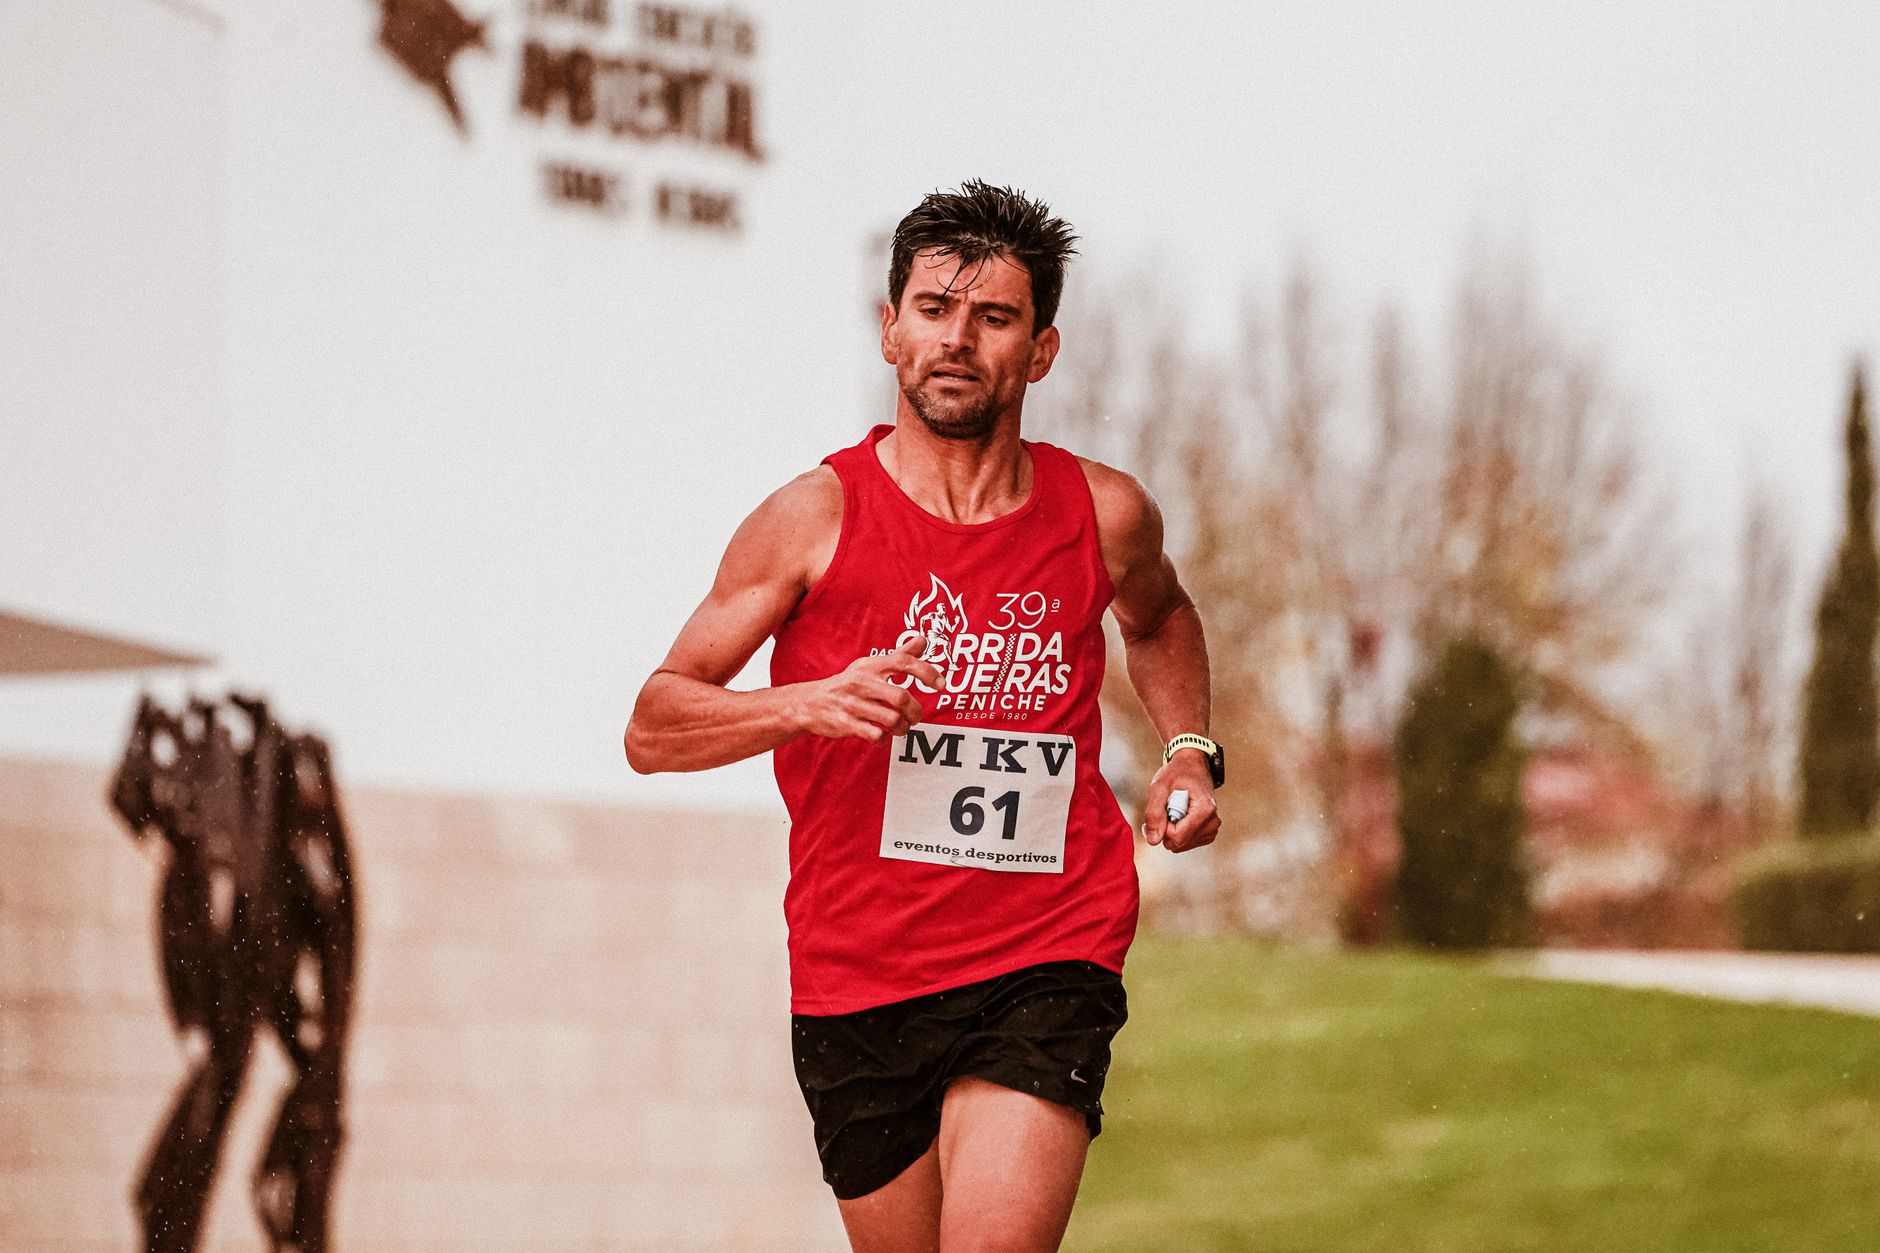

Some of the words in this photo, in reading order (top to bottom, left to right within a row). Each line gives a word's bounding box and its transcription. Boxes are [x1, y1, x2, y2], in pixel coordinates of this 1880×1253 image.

[936, 694, 1047, 711] PENICHE
[955, 712, 995, 720] DESDE
[1002, 712, 1028, 721] 1980
[949, 786, 1021, 840] 61
[893, 840, 960, 857] eventos
[964, 847, 1058, 864] desportivos
